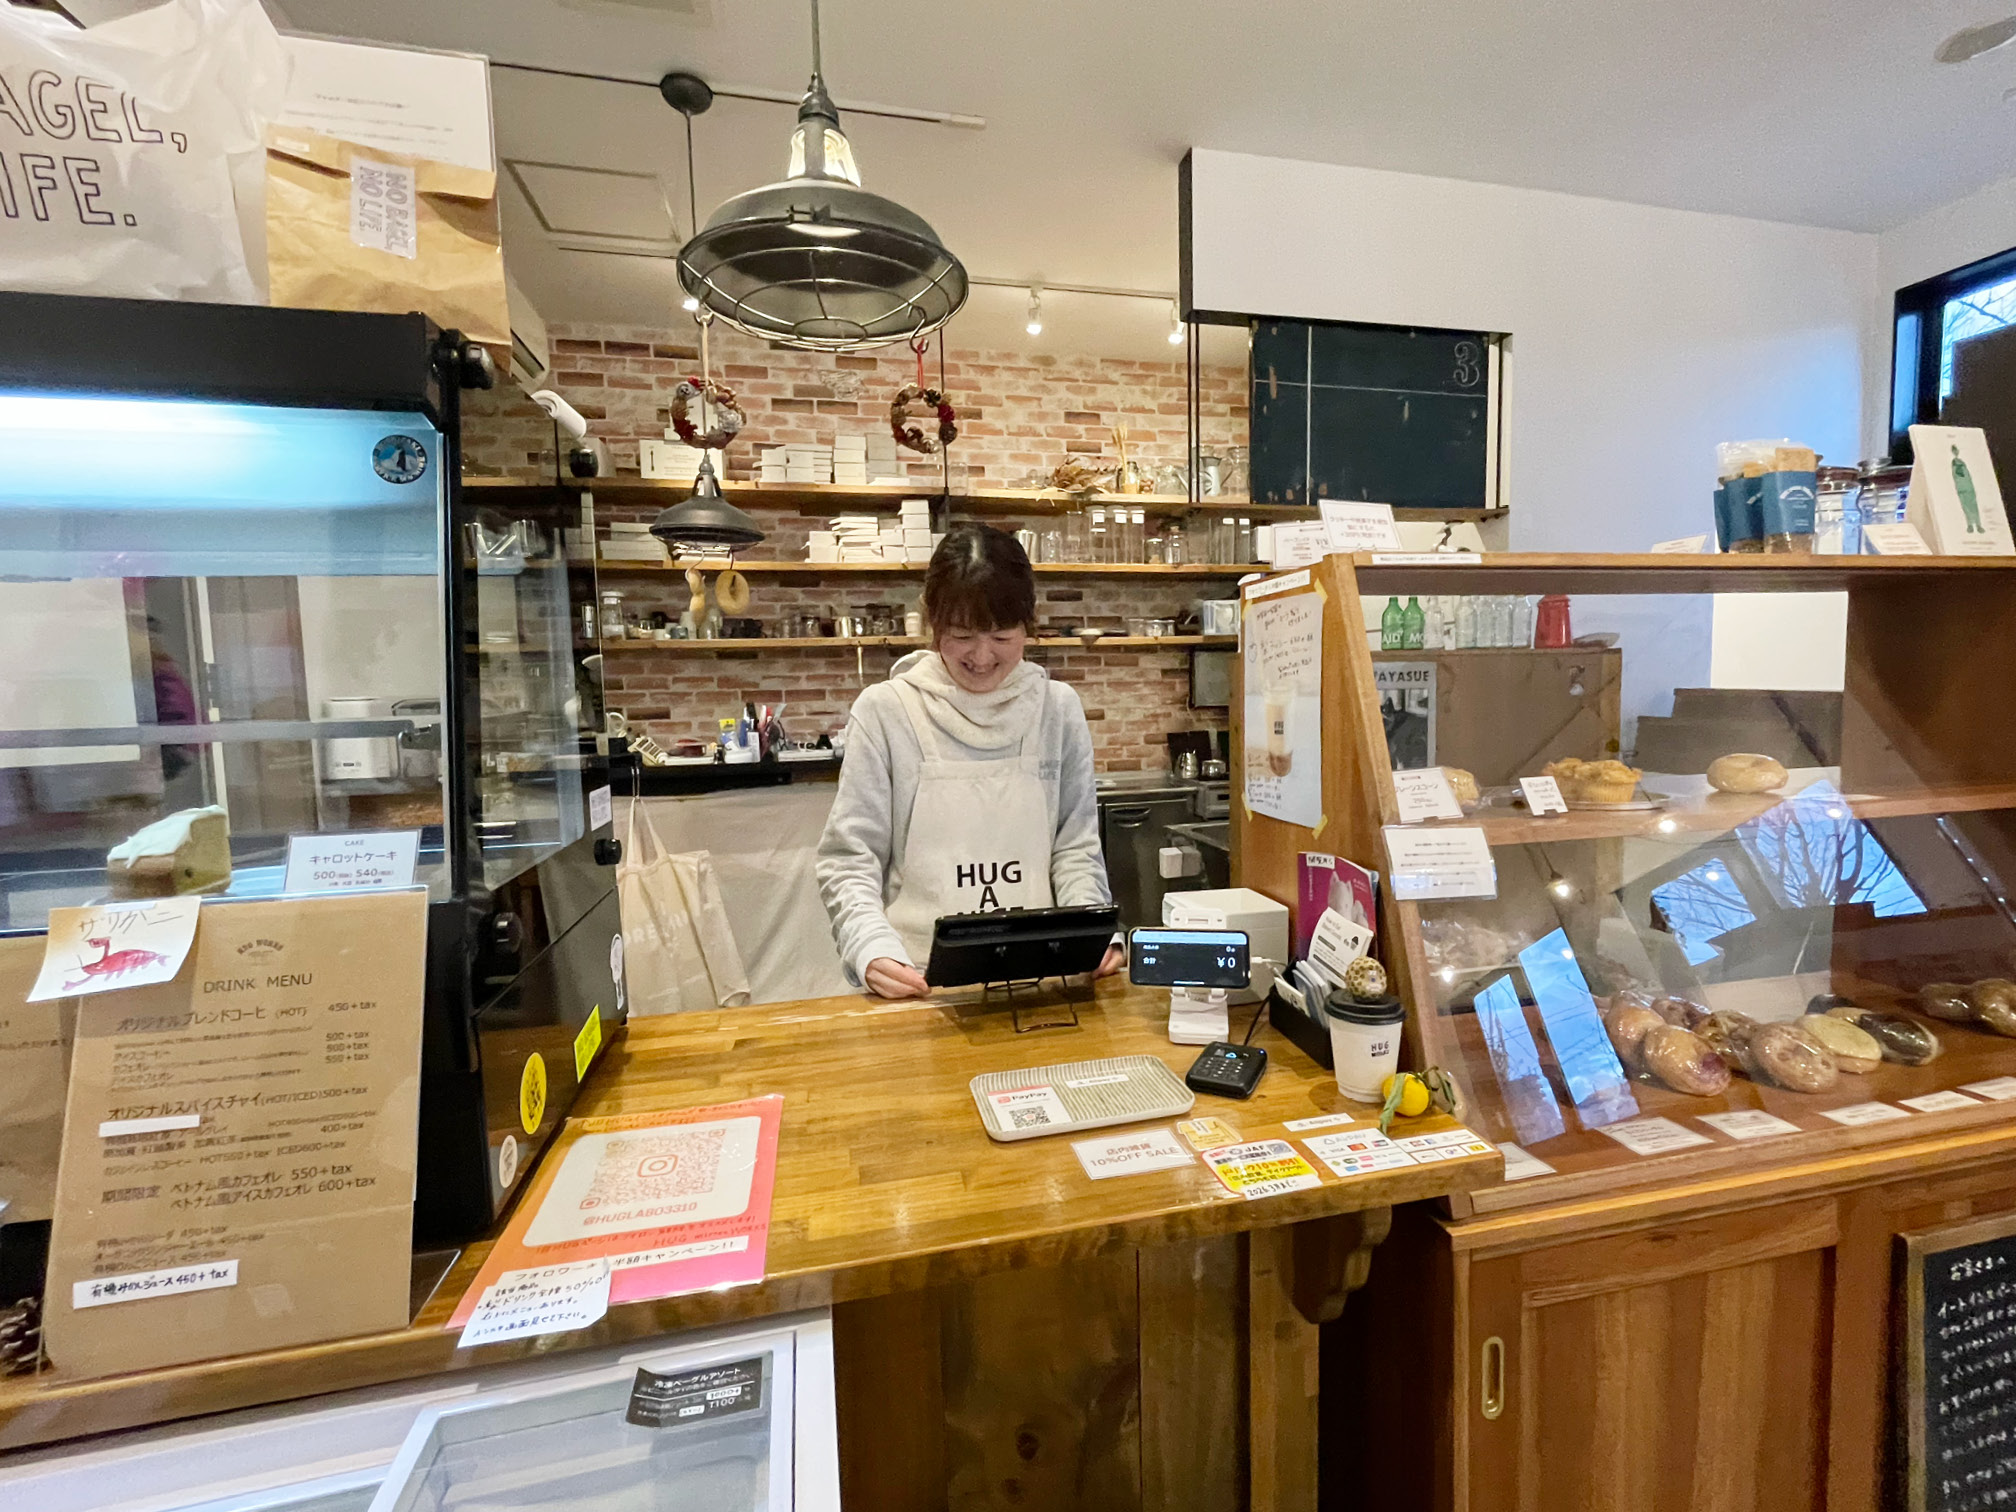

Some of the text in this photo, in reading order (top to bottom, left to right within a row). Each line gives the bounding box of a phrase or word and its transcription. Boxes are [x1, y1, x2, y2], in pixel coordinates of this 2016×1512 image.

[309, 851, 397, 864] キャロットケーキ
[956, 860, 1022, 888] HUG
[979, 886, 1000, 909] A
[203, 973, 313, 994] DRINK MENU
[1370, 1040, 1390, 1052] HUG
[1012, 1091, 1047, 1101] PayPay
[1146, 1146, 1180, 1158] SALE
